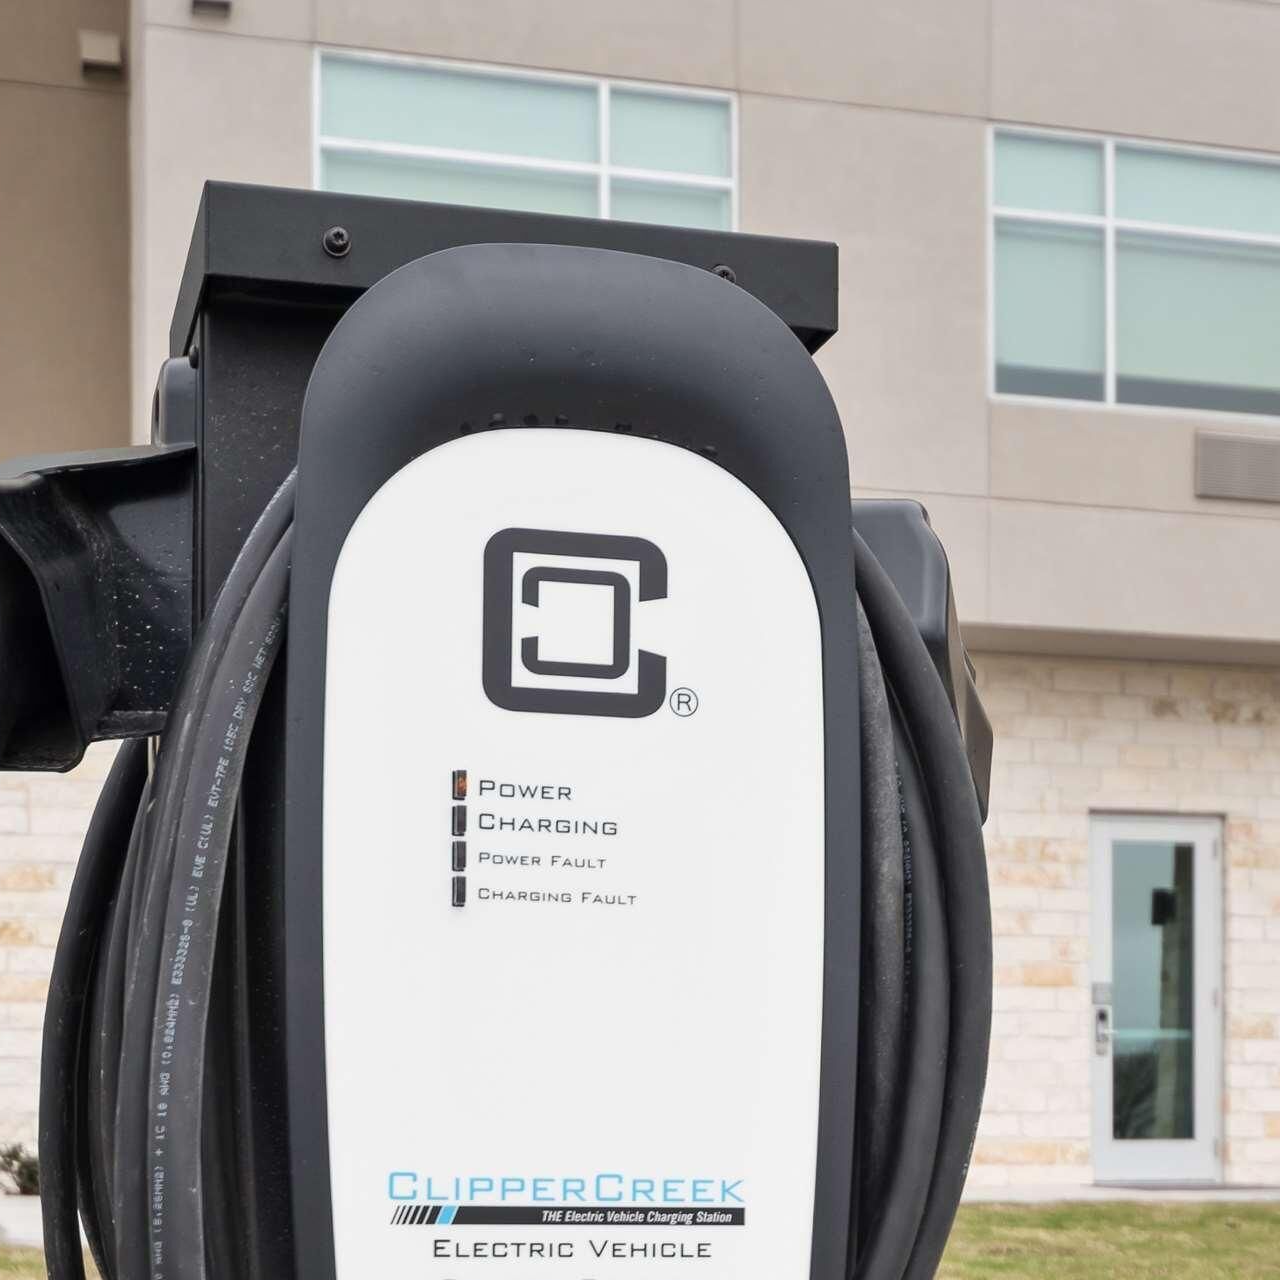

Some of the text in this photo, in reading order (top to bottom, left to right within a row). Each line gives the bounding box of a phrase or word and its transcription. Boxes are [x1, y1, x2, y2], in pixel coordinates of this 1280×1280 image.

[480, 780, 571, 800] POWER
[479, 813, 617, 835] CHARGING
[479, 852, 606, 868] POWER FAULT
[478, 888, 636, 904] CHARGING FAULT
[389, 1172, 743, 1202] CLIPPERCREEK
[543, 1211, 732, 1225] THE Electric Vehicle Charging Station
[434, 1239, 711, 1258] ELECTRIC VEHICLE
